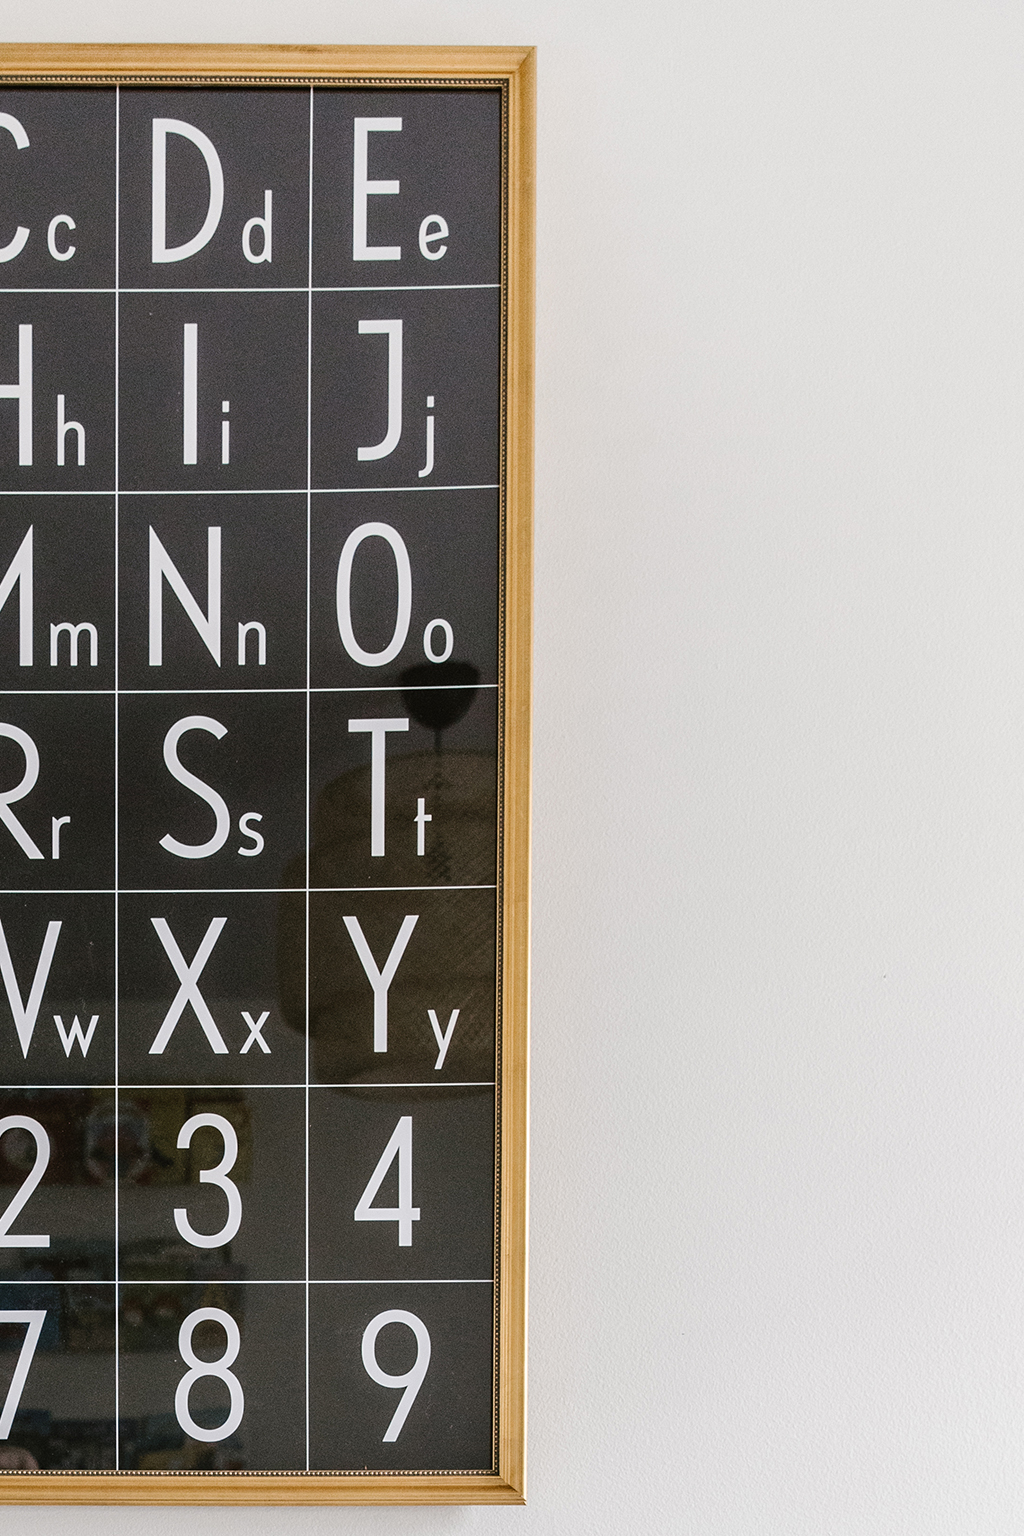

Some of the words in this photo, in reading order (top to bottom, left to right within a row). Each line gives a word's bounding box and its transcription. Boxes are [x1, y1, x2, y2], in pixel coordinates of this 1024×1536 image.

[173, 1112, 243, 1249] 3
[353, 1115, 421, 1247] 4
[174, 1306, 245, 1443] 8
[361, 1308, 432, 1443] 9
